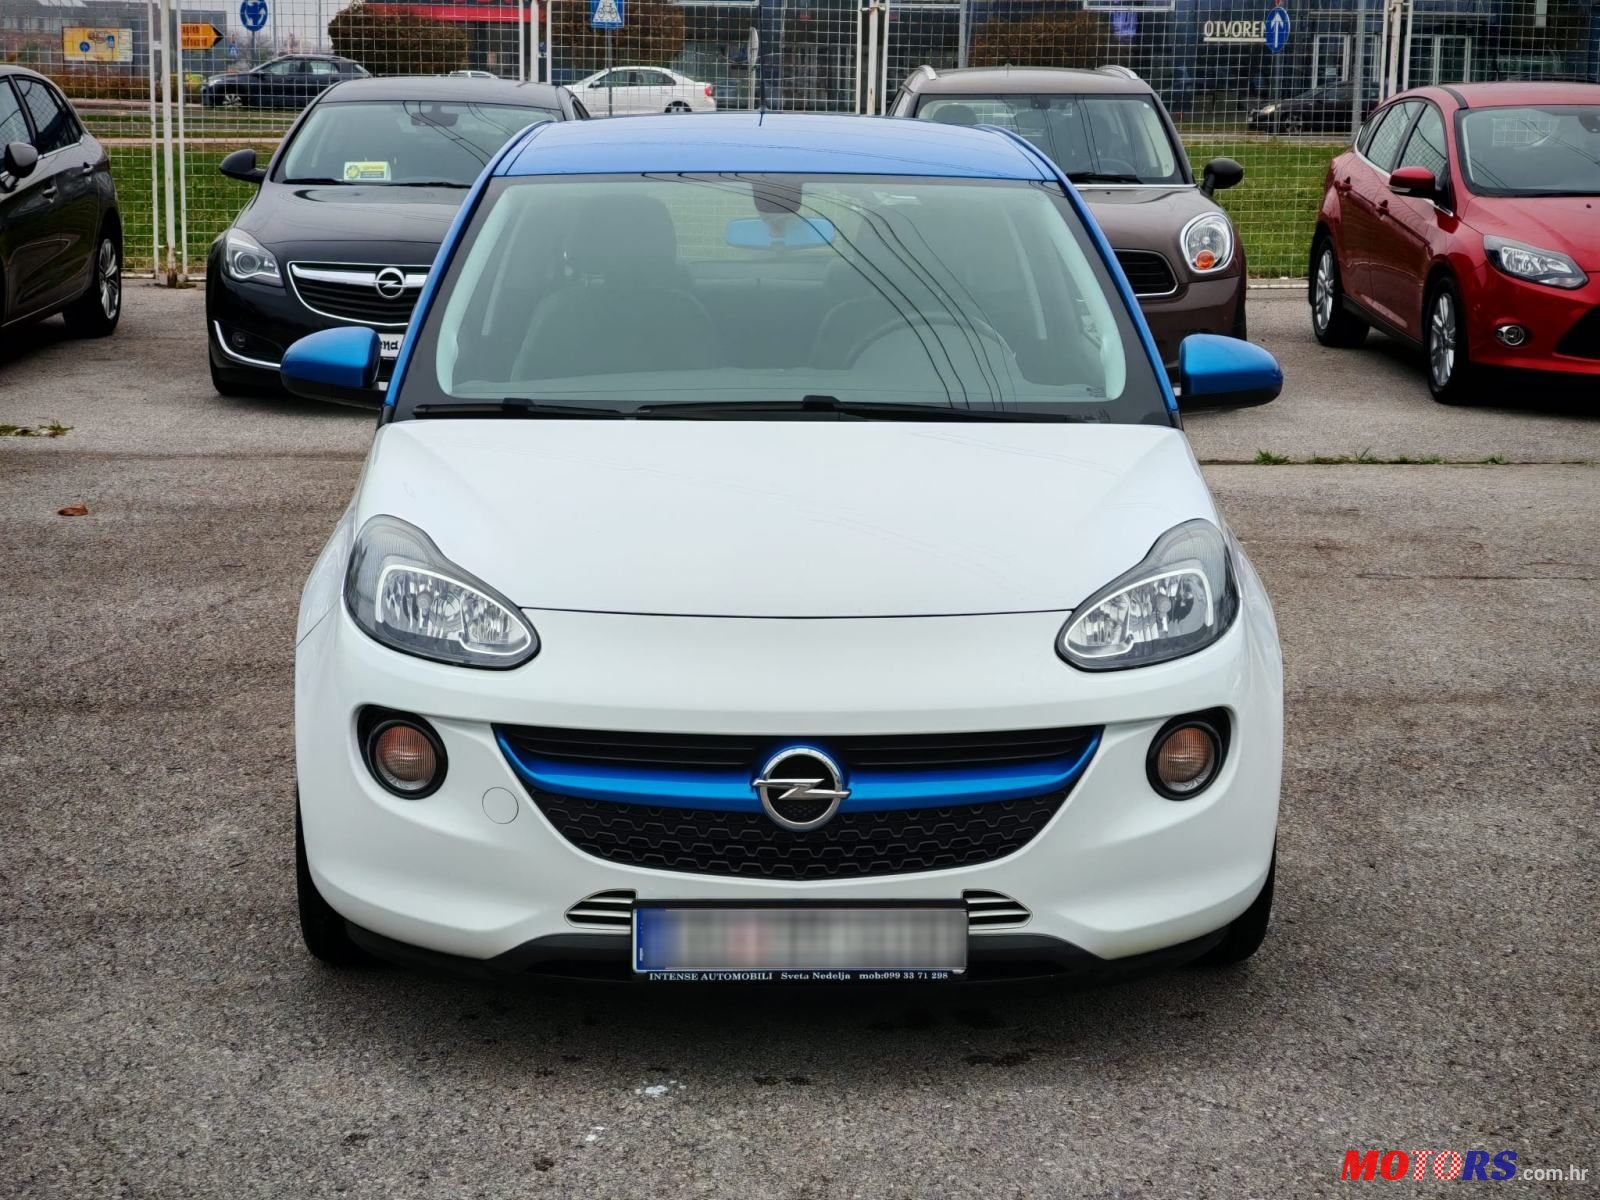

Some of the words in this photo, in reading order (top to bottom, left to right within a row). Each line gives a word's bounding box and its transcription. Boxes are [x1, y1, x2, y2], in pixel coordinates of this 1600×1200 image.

[649, 972, 699, 981] INTENSE
[700, 972, 773, 981] AUTOMOBILI
[780, 972, 809, 981] Sveta
[812, 972, 851, 981] Nedelja
[903, 972, 915, 980] 33
[918, 972, 929, 980] 71
